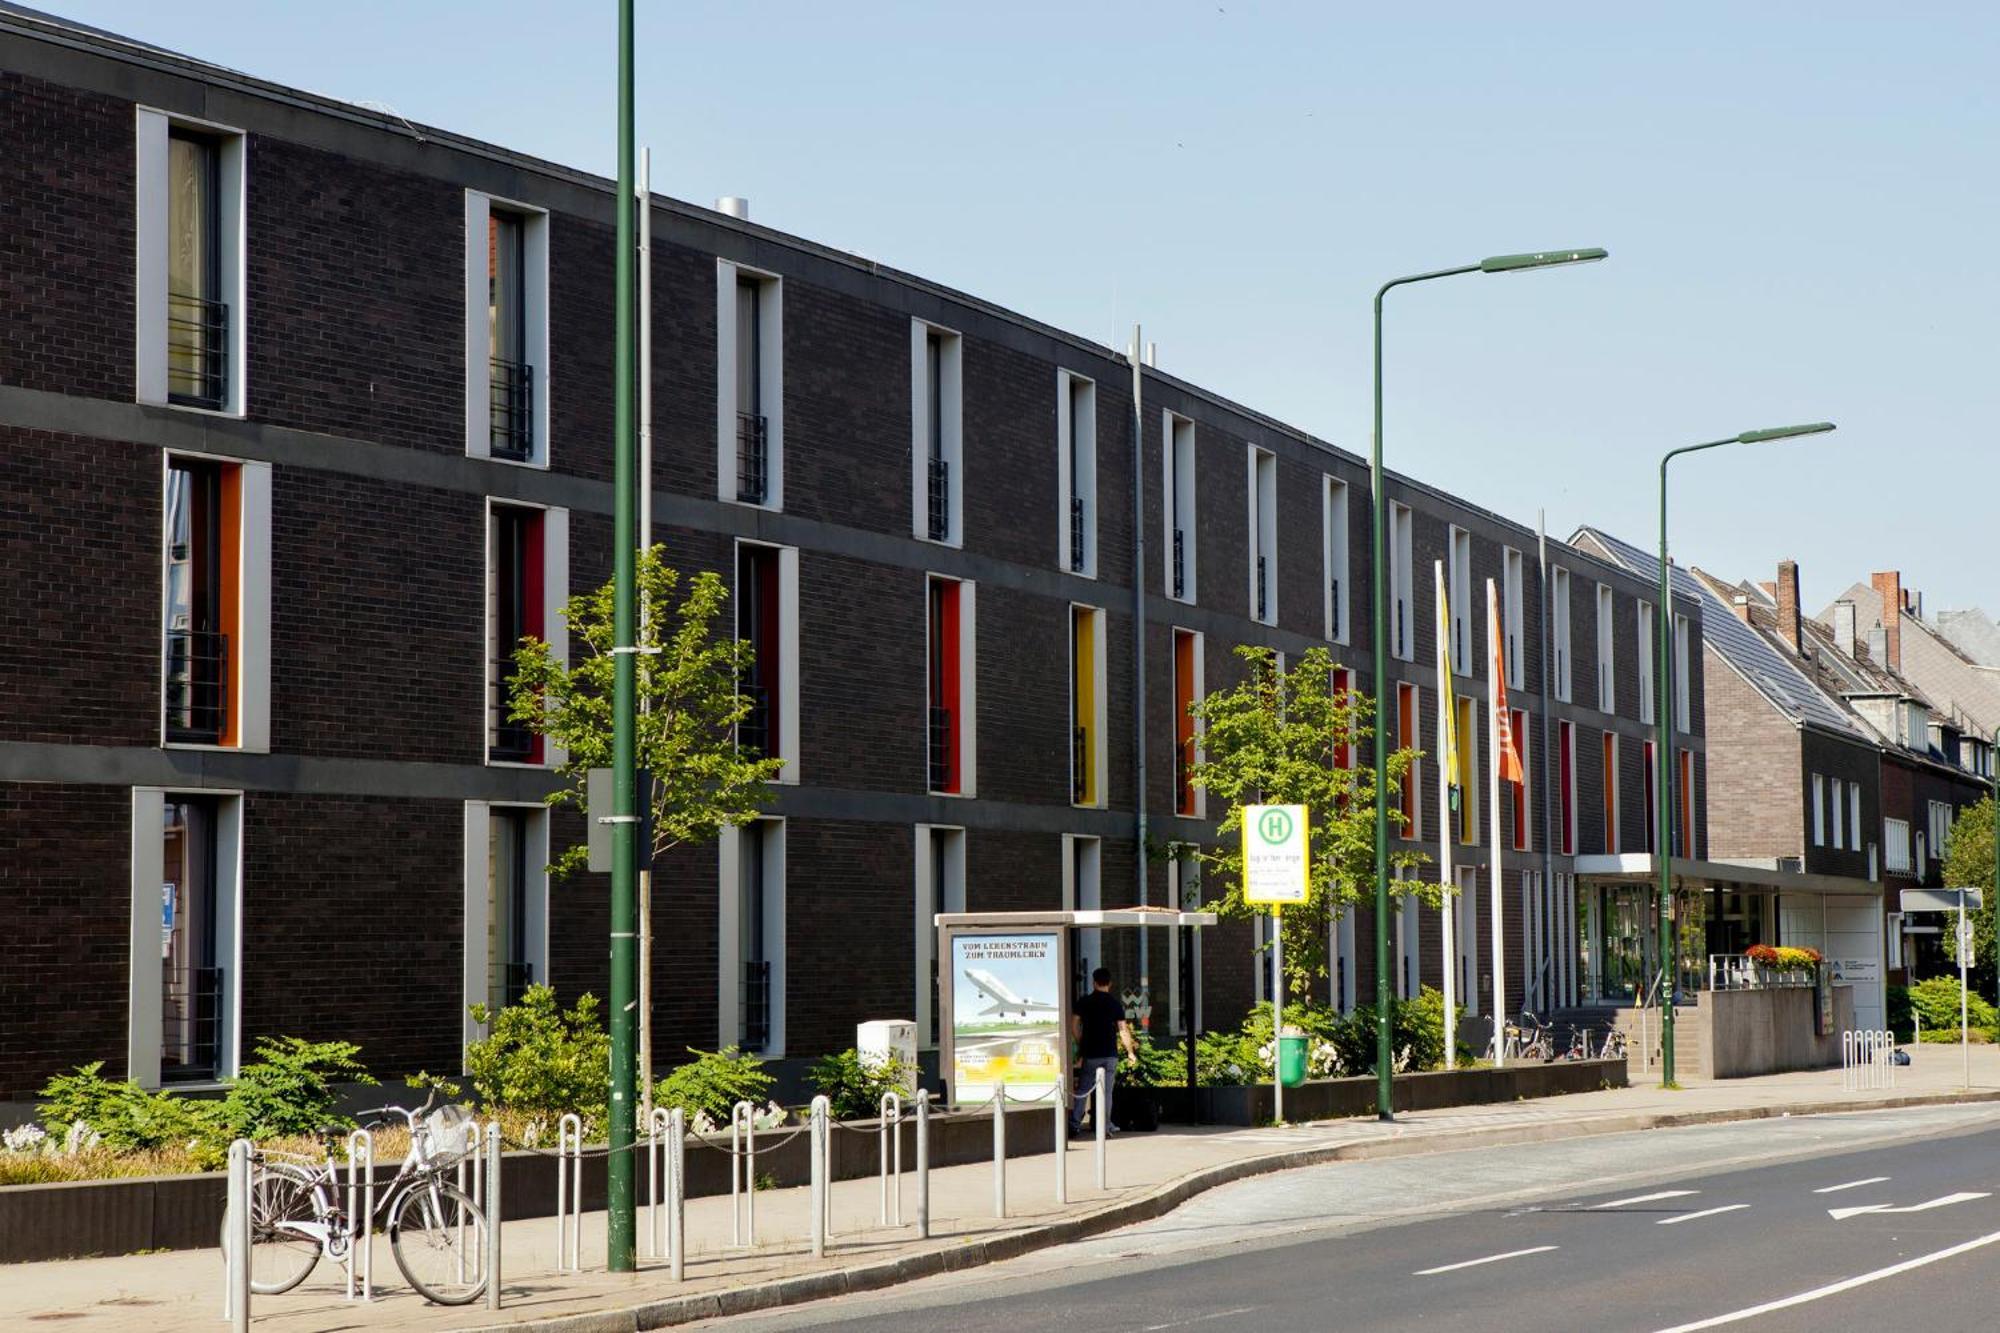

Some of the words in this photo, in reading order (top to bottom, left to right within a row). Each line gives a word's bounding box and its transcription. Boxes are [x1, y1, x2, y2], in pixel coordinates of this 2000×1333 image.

[1269, 817, 1282, 837] H
[983, 942, 1048, 950] LEBENSTRAUM
[986, 951, 1046, 959] TRAUMLEBEN
